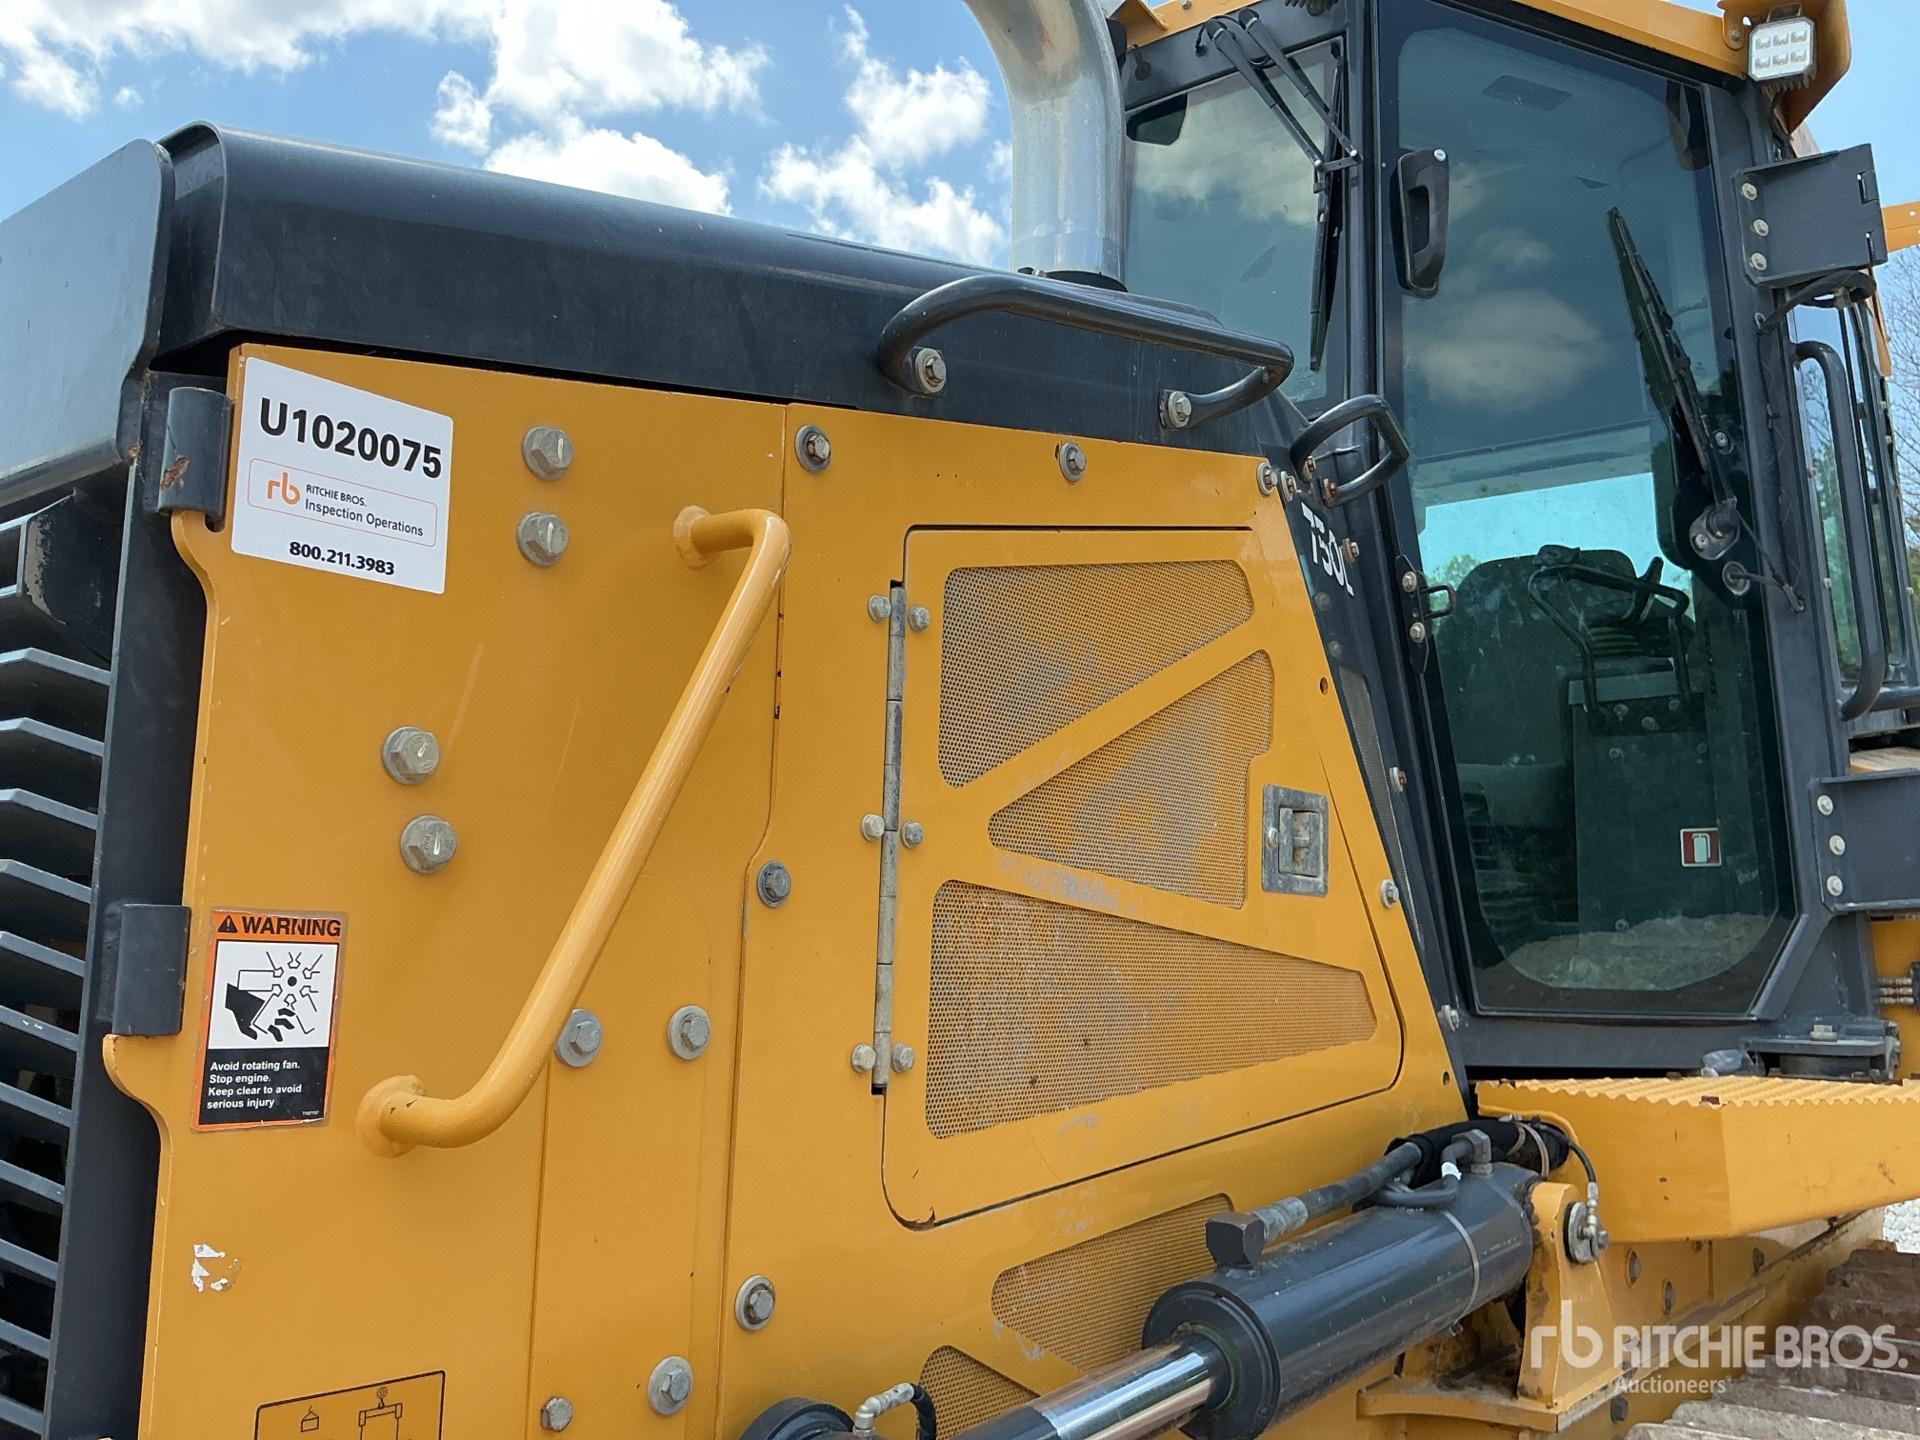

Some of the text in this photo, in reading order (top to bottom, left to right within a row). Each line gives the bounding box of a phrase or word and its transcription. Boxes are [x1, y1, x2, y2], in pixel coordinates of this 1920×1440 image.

[260, 397, 441, 479] U1020075
[267, 472, 300, 505] rb
[306, 484, 367, 507] RITCHIE BROS.
[305, 499, 423, 537] Inspection Operations
[289, 541, 395, 576] 800.211.3983
[242, 916, 341, 936] WARNING
[210, 1059, 300, 1072] Avoid rotating fan.
[209, 1073, 271, 1085] Stop engine.
[208, 1084, 301, 1097] Keep clear to avoid
[207, 1097, 275, 1109] serious injury
